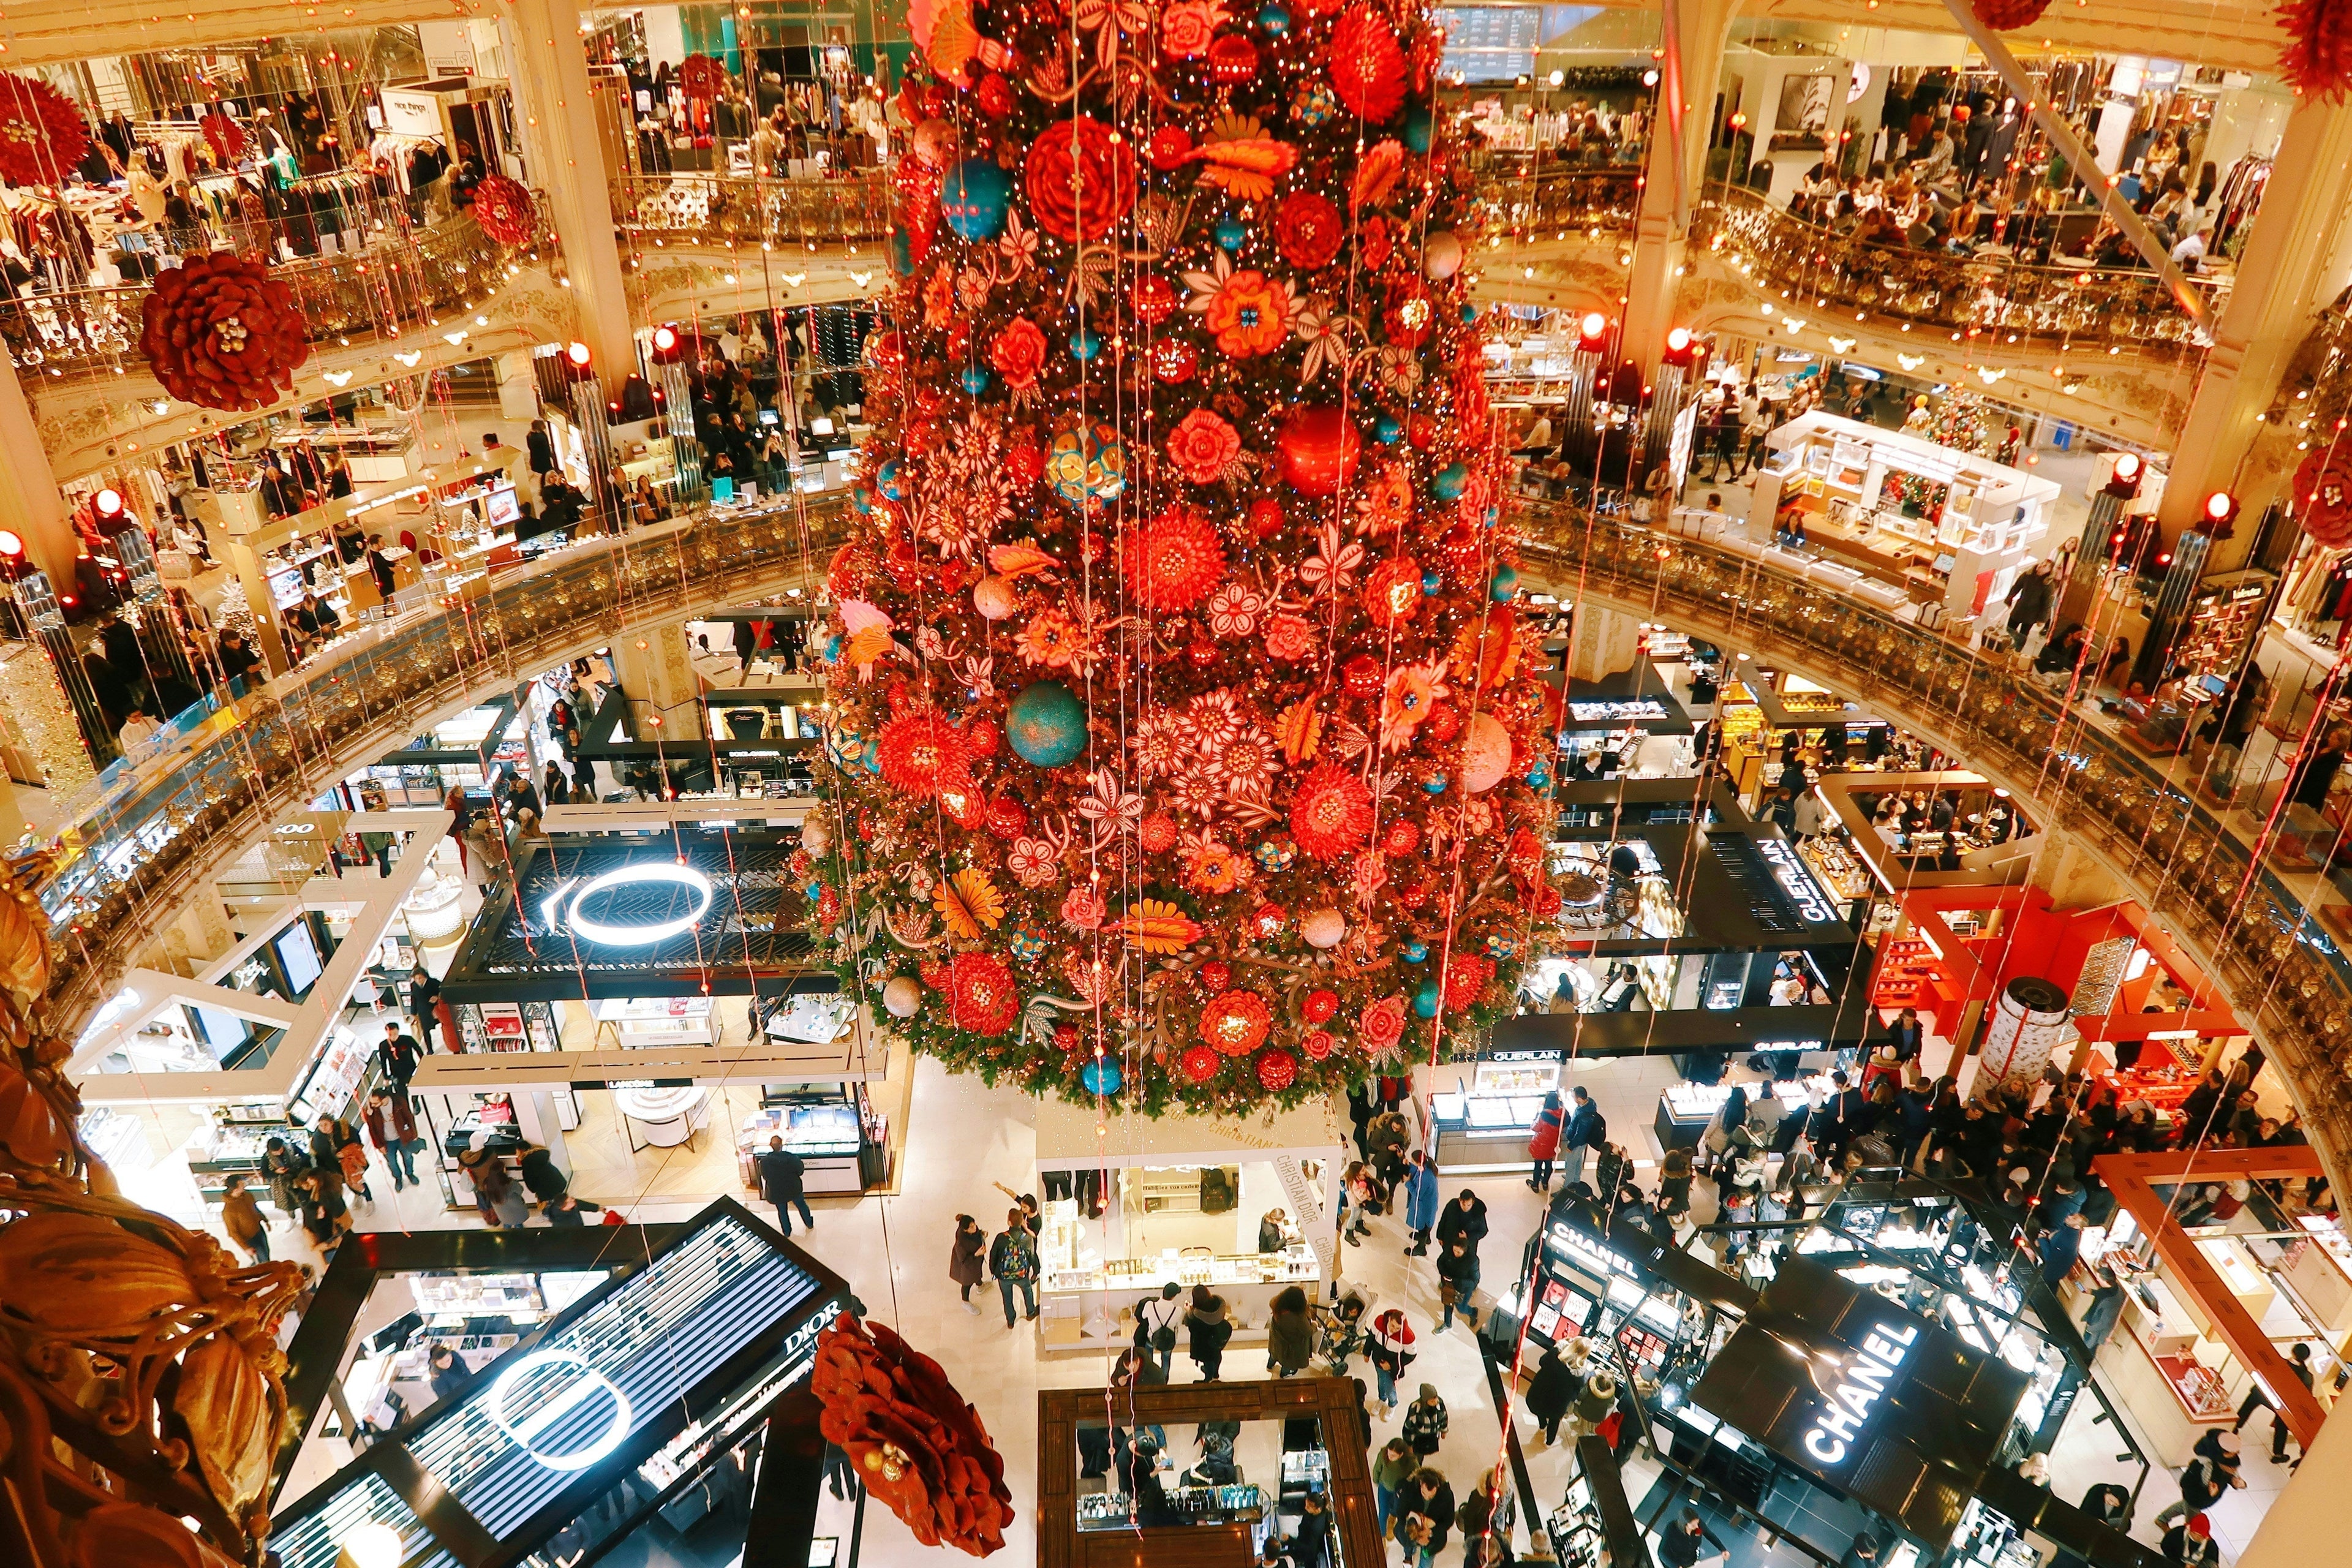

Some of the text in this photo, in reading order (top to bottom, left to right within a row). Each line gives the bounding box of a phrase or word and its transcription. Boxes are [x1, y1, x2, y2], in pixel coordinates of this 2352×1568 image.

[407, 102, 426, 113] things
[1568, 701, 1667, 715] PRADA
[1756, 839, 1826, 922] GUERLAIN
[1493, 1052, 1561, 1061] GUERLAIN
[1754, 1041, 1822, 1052] GUERLAIN
[1276, 1154, 1318, 1225] CHRISTIAN DIOR
[1553, 1222, 1639, 1279] CHANEL
[784, 1300, 842, 1356] DIOR
[1804, 1322, 1918, 1463] CHANEL
